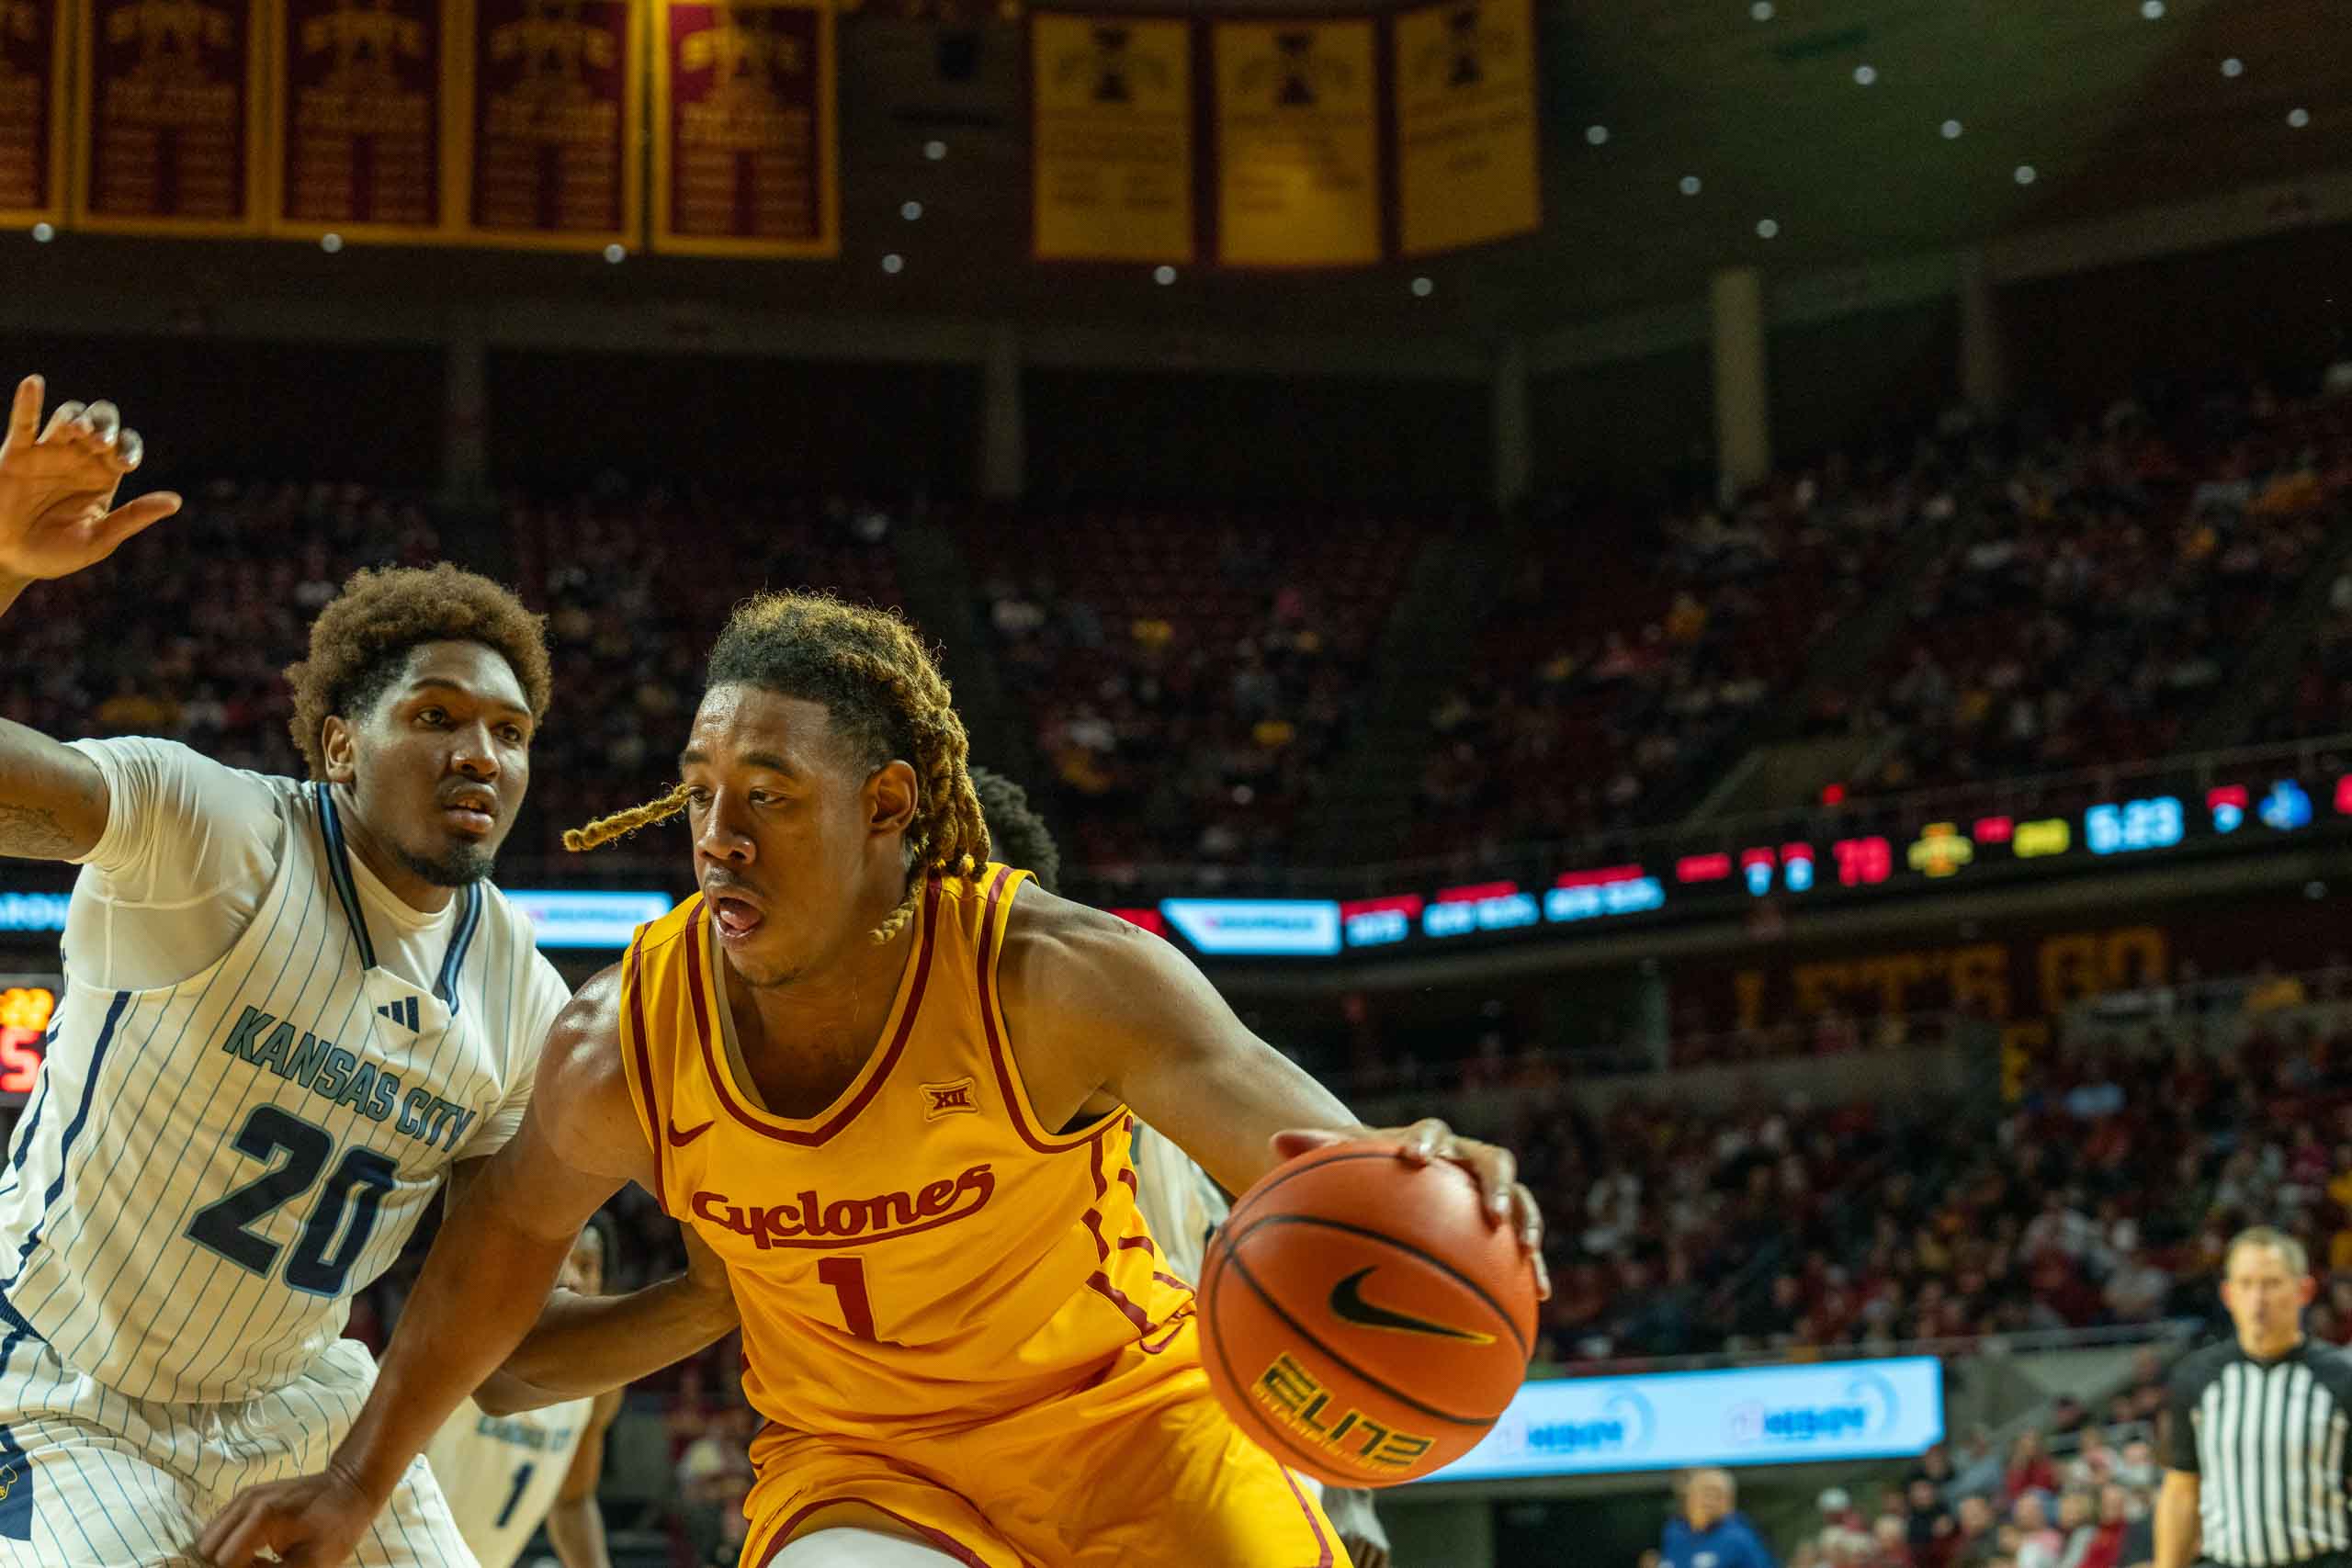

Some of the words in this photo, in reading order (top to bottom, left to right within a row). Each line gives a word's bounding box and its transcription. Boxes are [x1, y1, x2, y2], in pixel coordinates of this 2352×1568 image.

[222, 1005, 401, 1122] KANSAS
[395, 1088, 477, 1153] CITY
[182, 1102, 400, 1299] 20
[692, 1163, 995, 1250] Cyclones
[818, 1257, 880, 1342] 1
[1255, 1352, 1436, 1470] ELITE
[492, 1462, 536, 1529] 1
